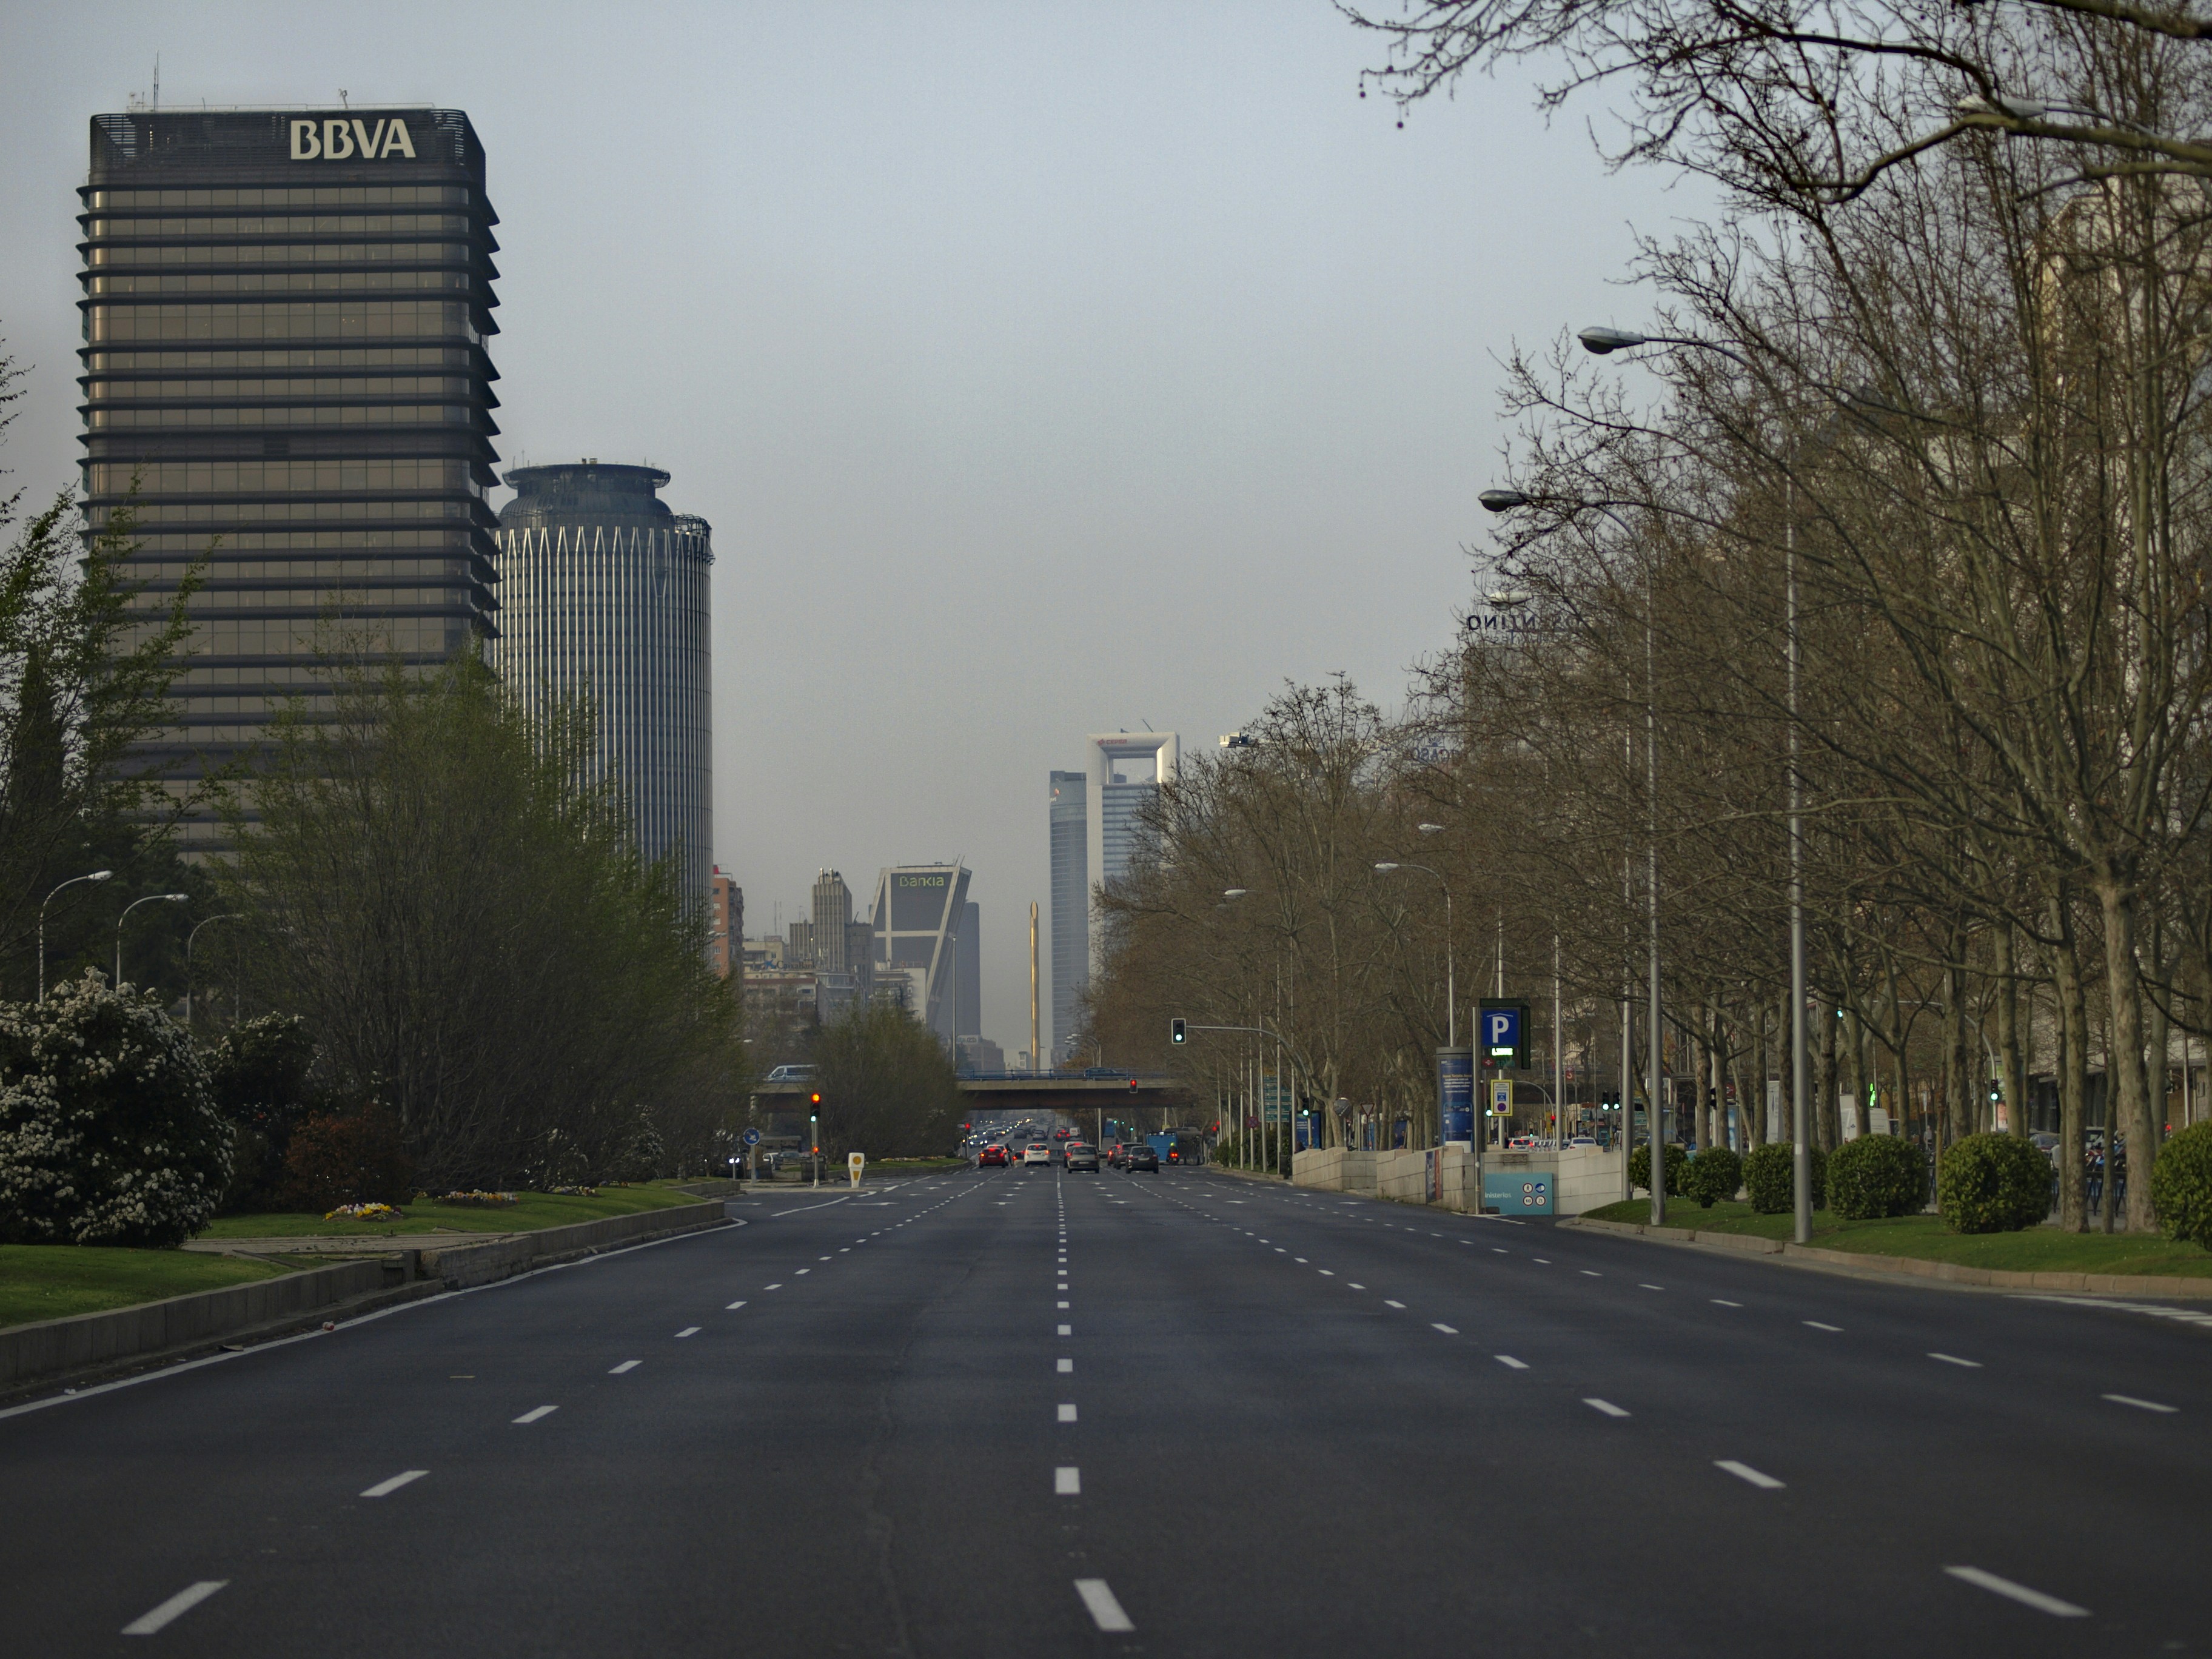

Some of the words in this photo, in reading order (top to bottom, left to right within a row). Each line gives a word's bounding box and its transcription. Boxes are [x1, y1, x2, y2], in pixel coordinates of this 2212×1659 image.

[290, 118, 417, 159] BBVA
[899, 876, 944, 886] Bankia
[1492, 1016, 1509, 1043] P
